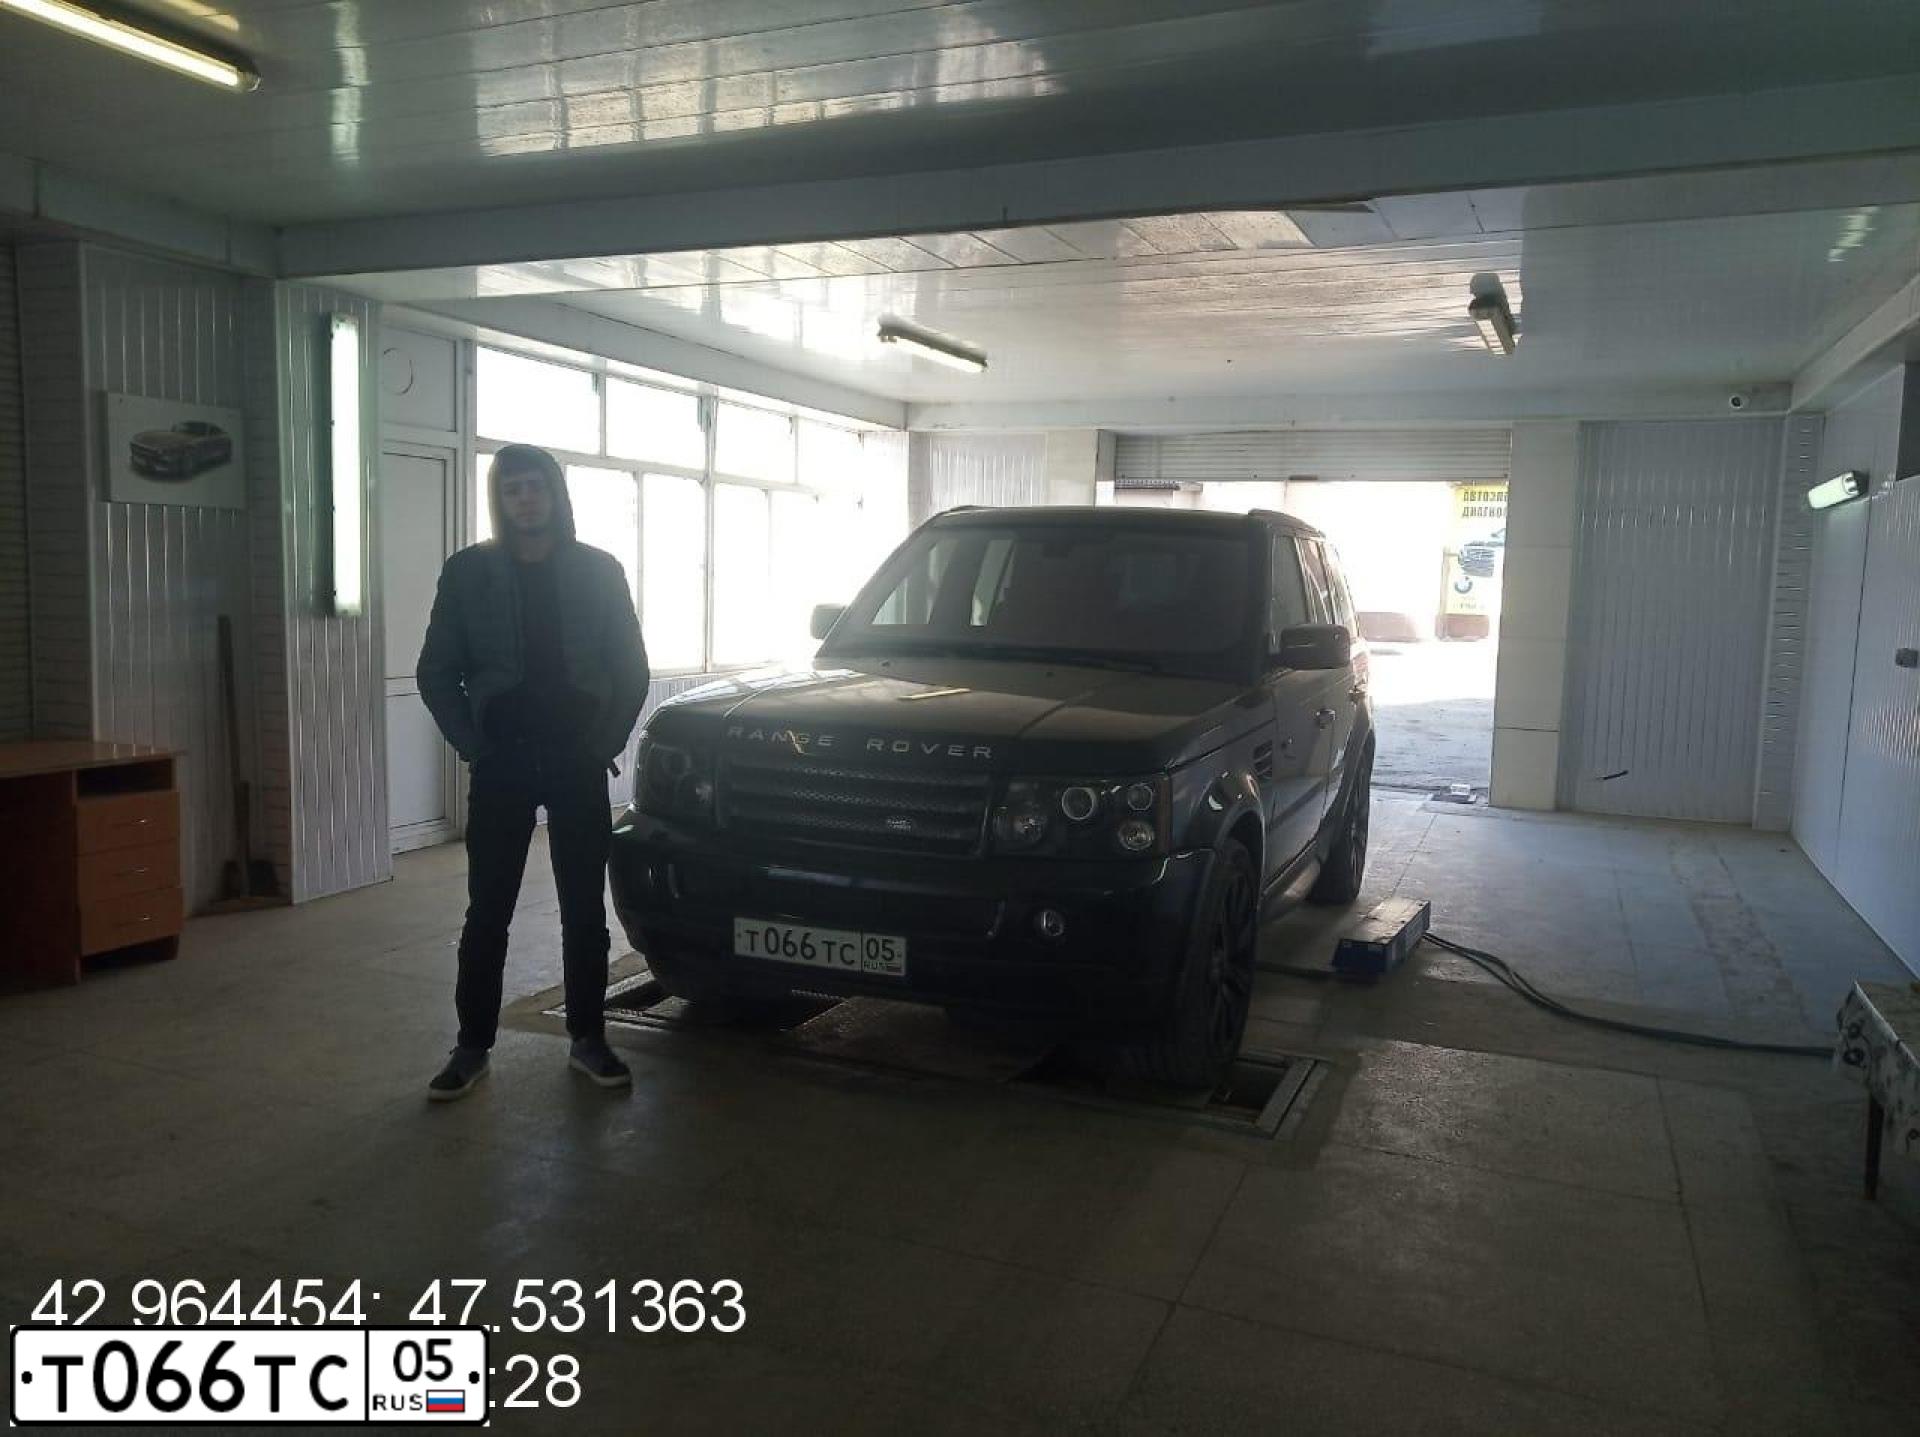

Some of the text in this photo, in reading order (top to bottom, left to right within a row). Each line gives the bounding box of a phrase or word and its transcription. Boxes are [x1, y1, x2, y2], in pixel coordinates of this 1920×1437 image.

[727, 725, 993, 759] RANGE ROVER
[744, 926, 895, 966] Т066ТС 05
